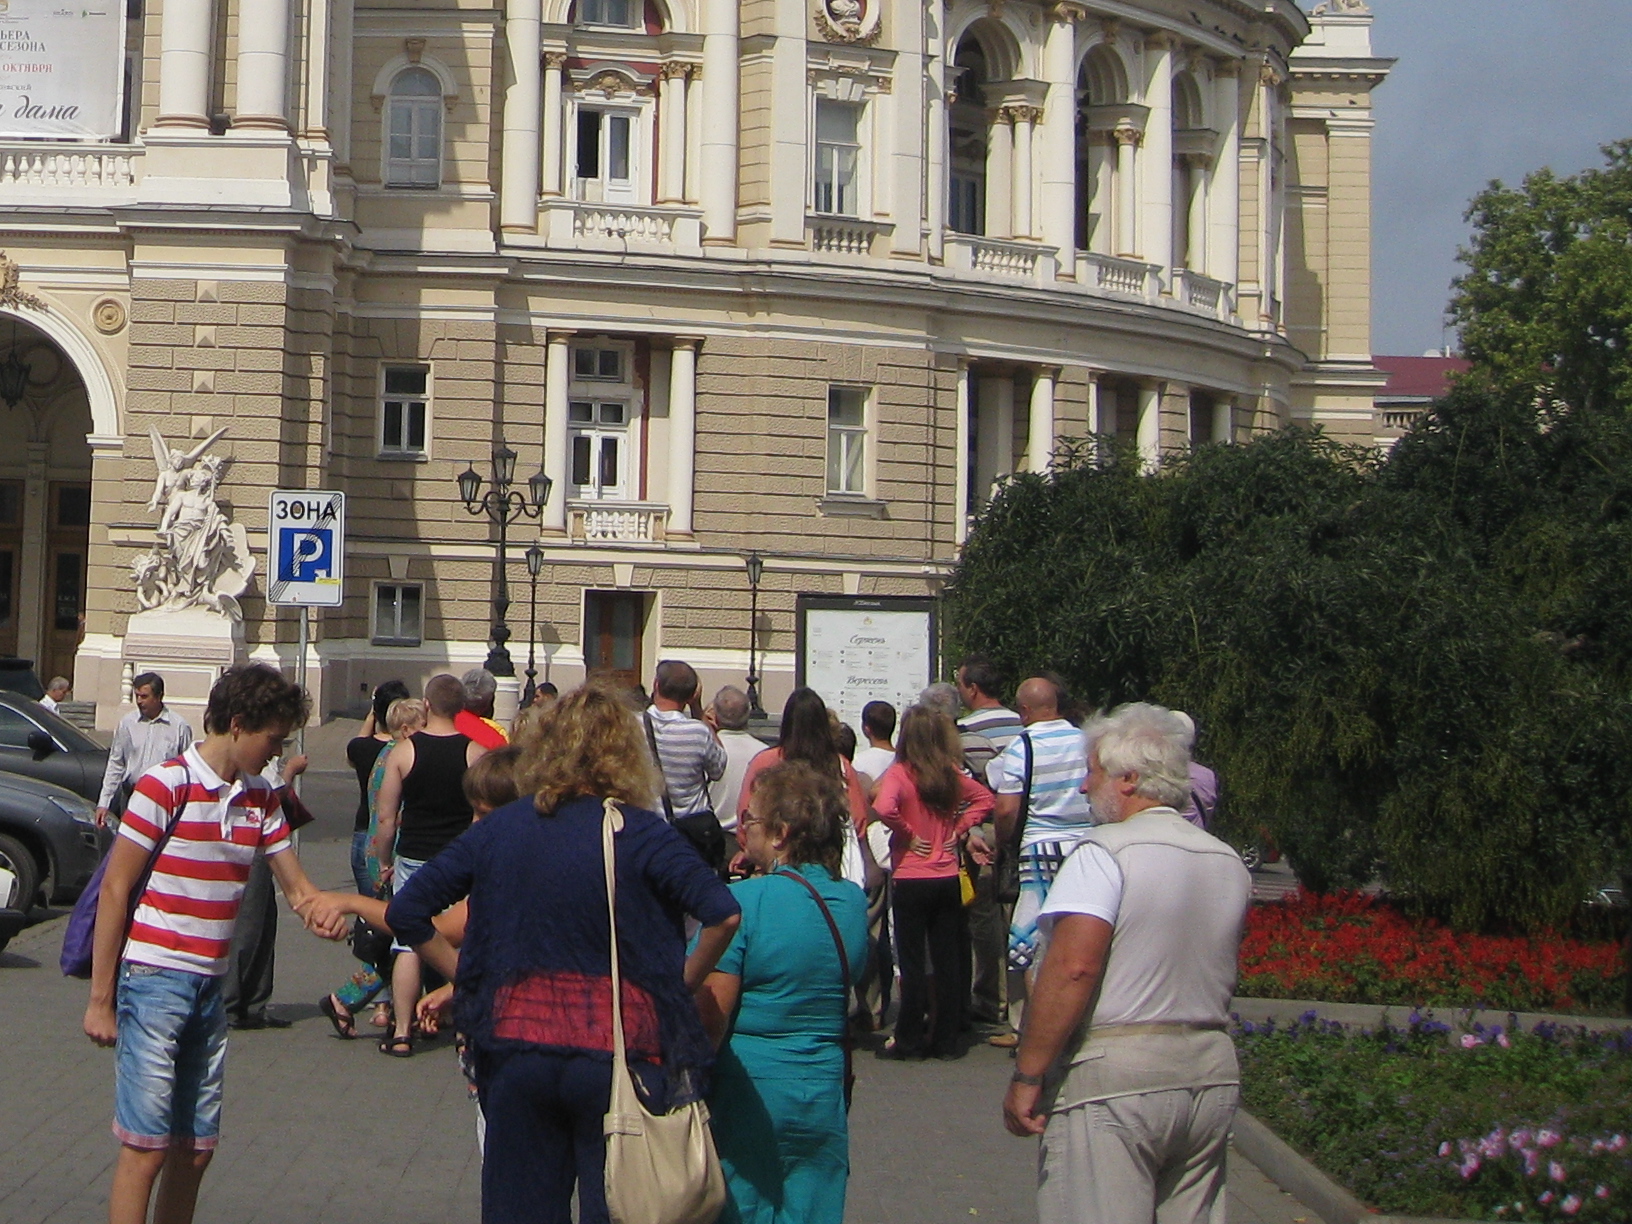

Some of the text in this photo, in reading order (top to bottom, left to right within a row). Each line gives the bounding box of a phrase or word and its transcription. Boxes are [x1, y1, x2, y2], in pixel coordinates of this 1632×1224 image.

[0, 41, 46, 53] СЕЗОНА
[14, 94, 81, 121] дама
[276, 500, 337, 521] ЗОНА
